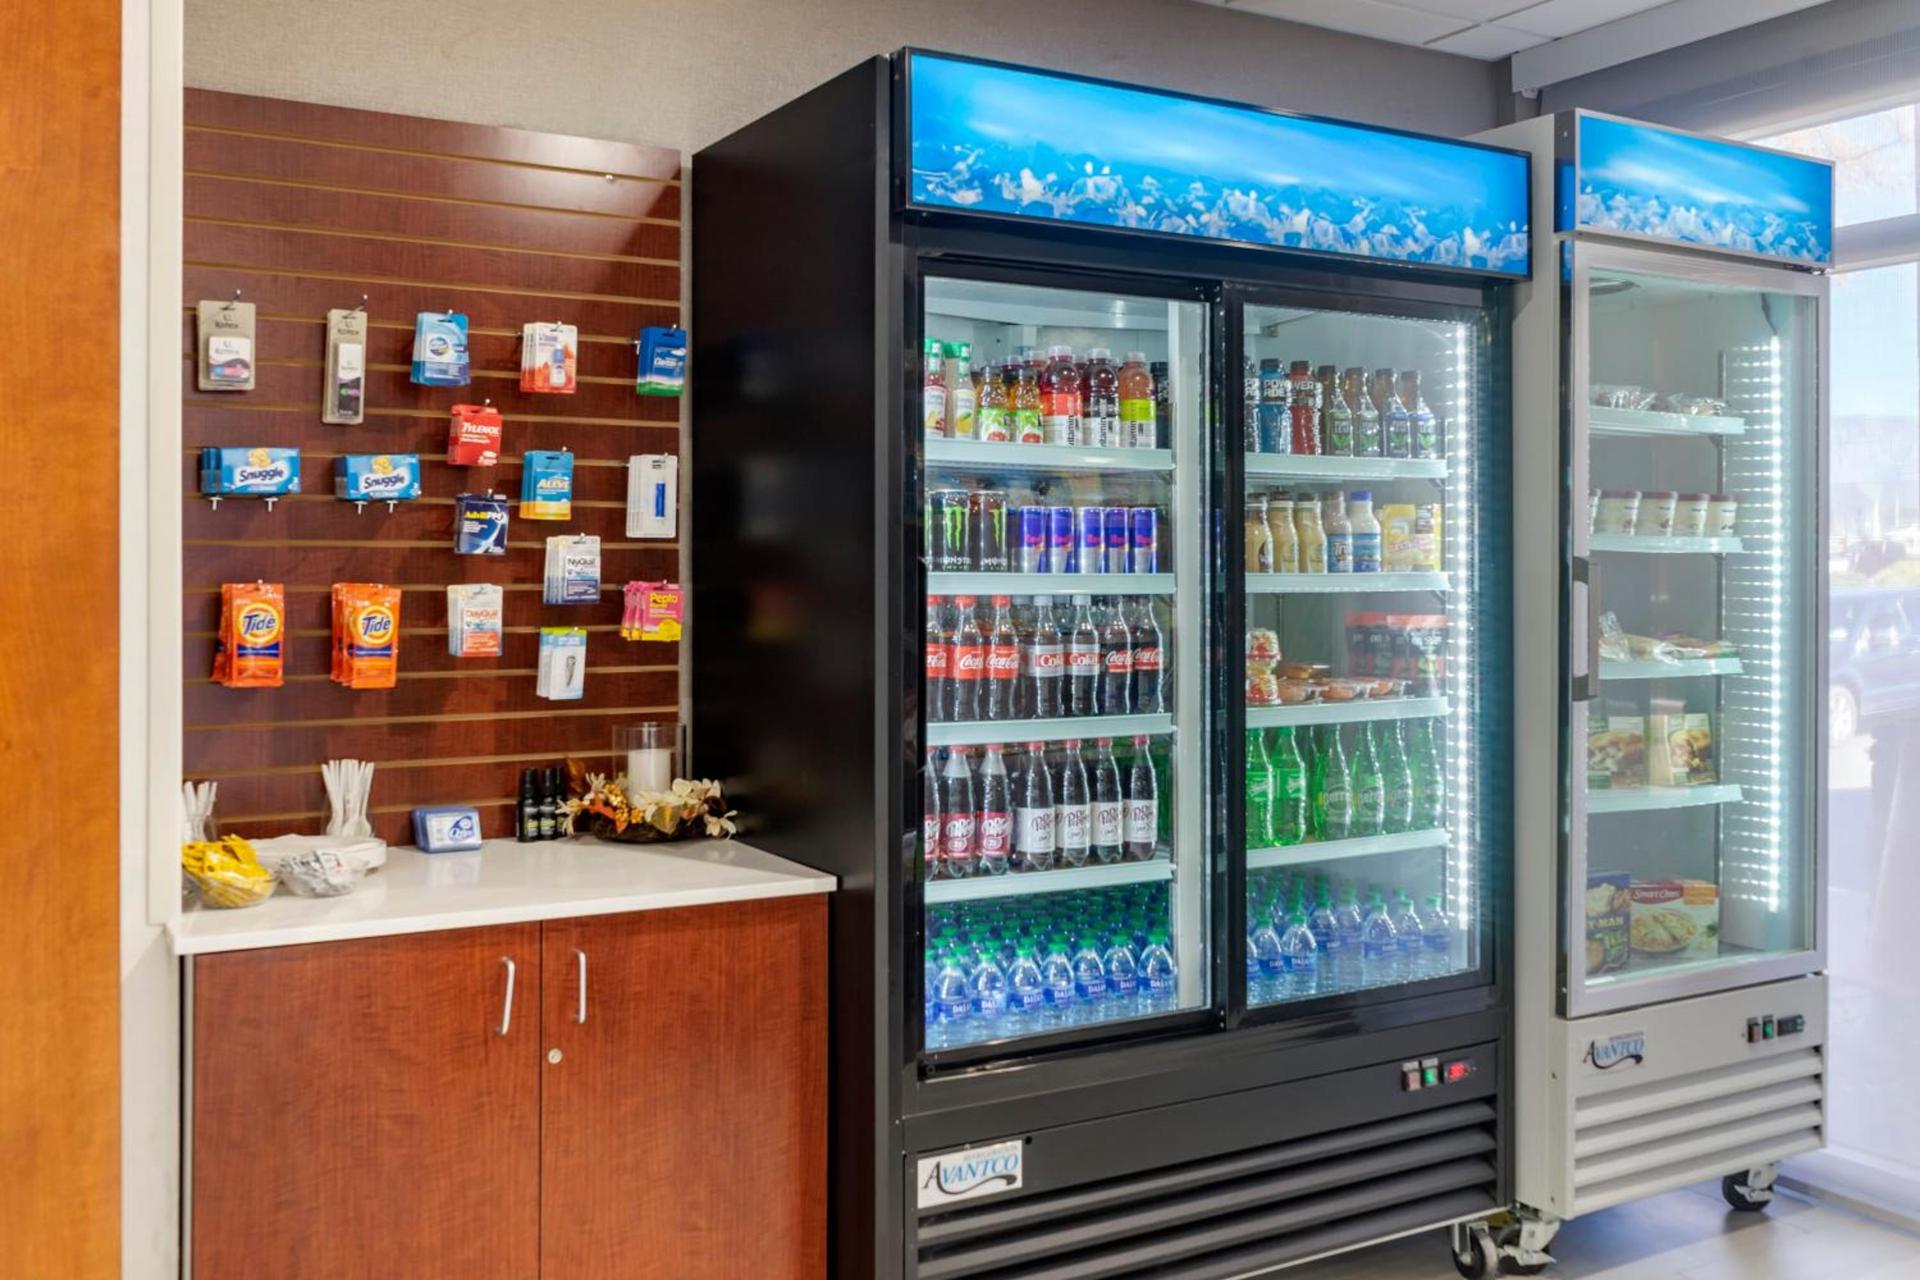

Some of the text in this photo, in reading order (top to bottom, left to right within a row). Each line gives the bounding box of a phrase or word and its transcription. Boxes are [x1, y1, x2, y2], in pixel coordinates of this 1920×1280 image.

[239, 467, 284, 483] Snuggle
[363, 474, 405, 490] Snuggle
[242, 612, 276, 635] Tide
[362, 615, 391, 636] Tide
[1583, 1037, 1647, 1069] AVANTCO
[922, 1154, 1019, 1194] AVANTCO
